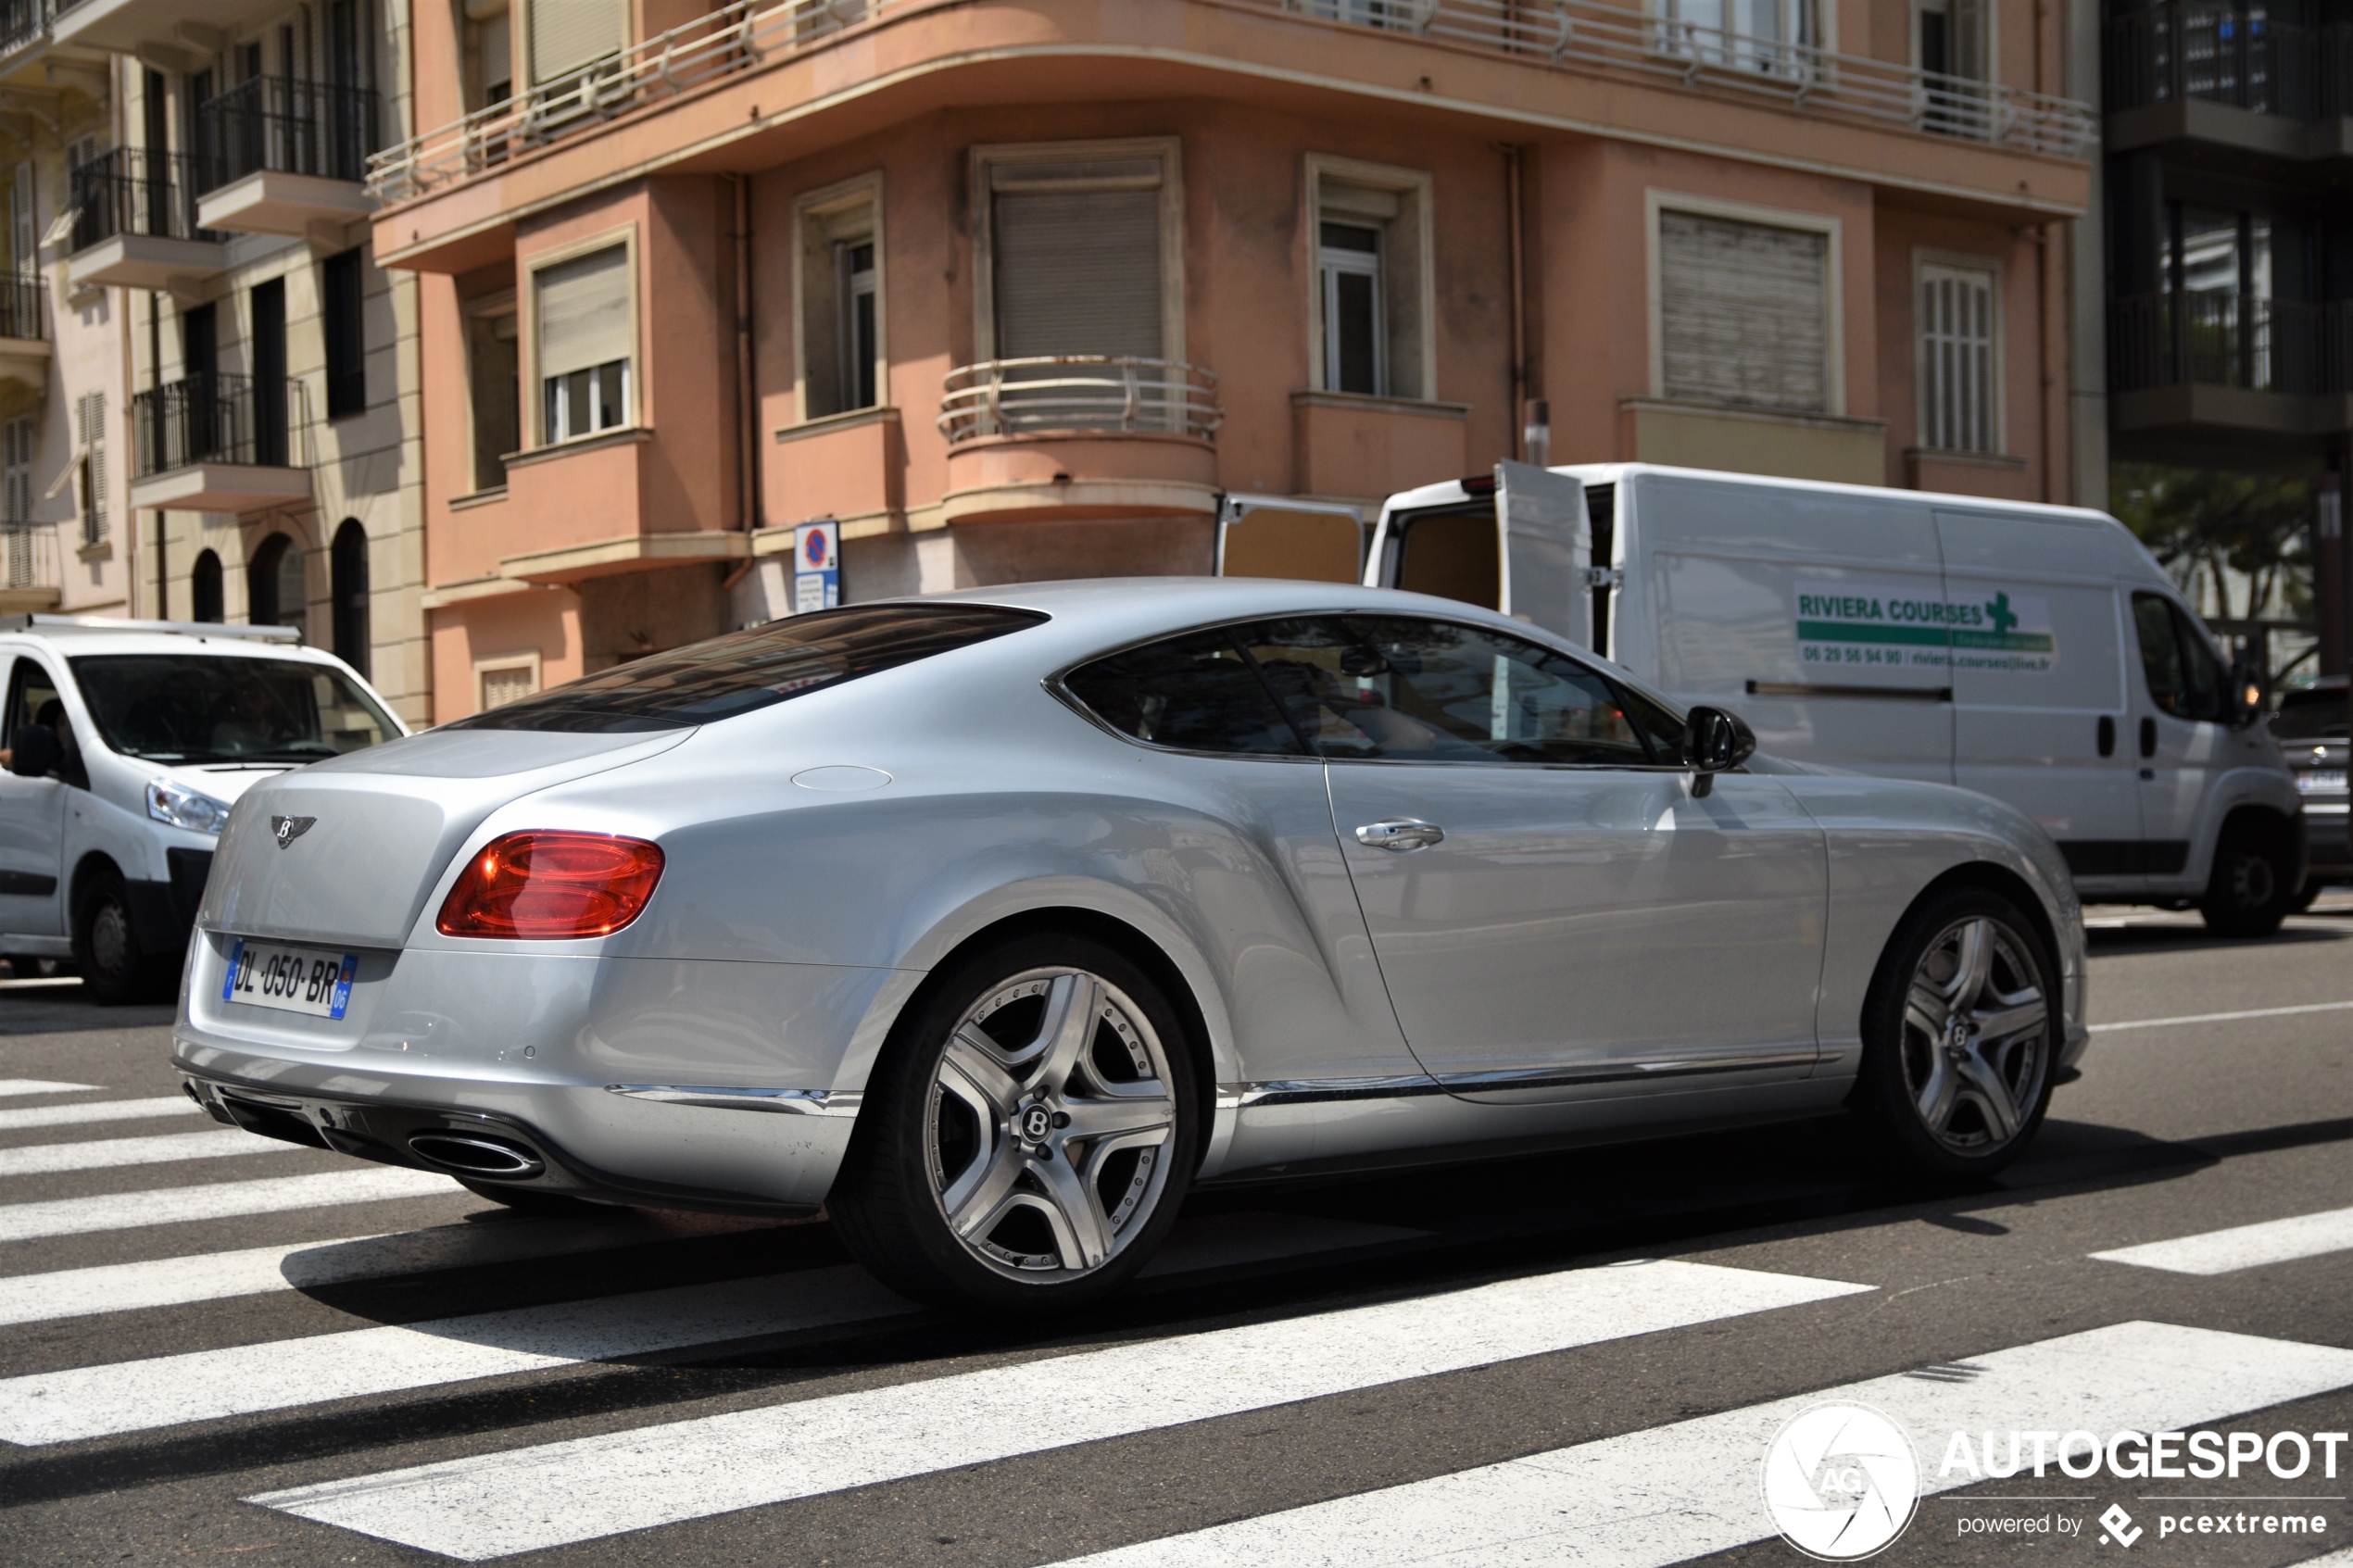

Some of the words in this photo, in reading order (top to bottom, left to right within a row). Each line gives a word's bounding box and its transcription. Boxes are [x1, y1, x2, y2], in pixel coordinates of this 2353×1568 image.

[1799, 595, 1883, 620] RIVIERA
[1888, 599, 1983, 626] COURSES
[1803, 646, 1821, 662] 06
[1824, 646, 1843, 663] 29
[1866, 648, 1882, 664] 94
[333, 989, 347, 1010] 06
[1027, 1110, 1048, 1135] B
